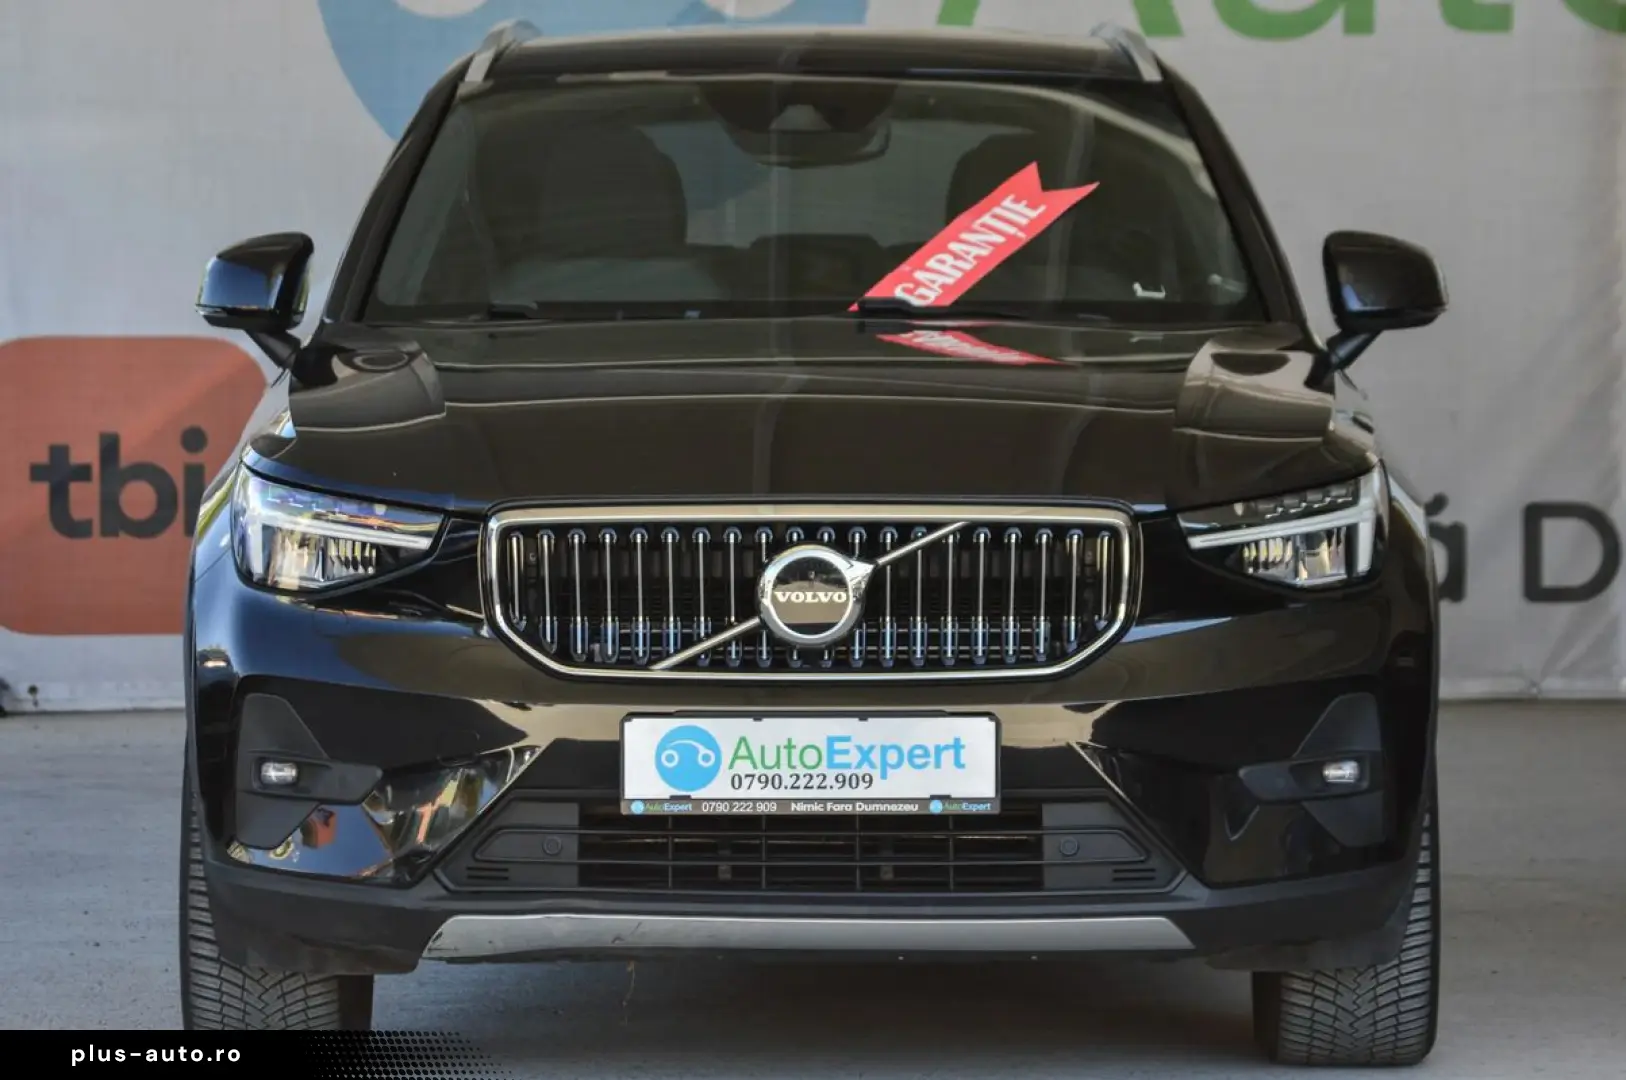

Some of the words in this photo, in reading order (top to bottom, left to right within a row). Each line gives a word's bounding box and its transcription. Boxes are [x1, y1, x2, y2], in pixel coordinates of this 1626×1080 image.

[29, 426, 208, 539] tbi
[774, 591, 847, 603] VOLVO
[729, 736, 966, 779] AutoExpert
[731, 772, 873, 790] 0790.222.909
[702, 802, 729, 812] 0790
[732, 802, 753, 812] 222
[757, 802, 777, 812] 909
[791, 802, 823, 812] Nimic
[827, 802, 852, 812] Fara
